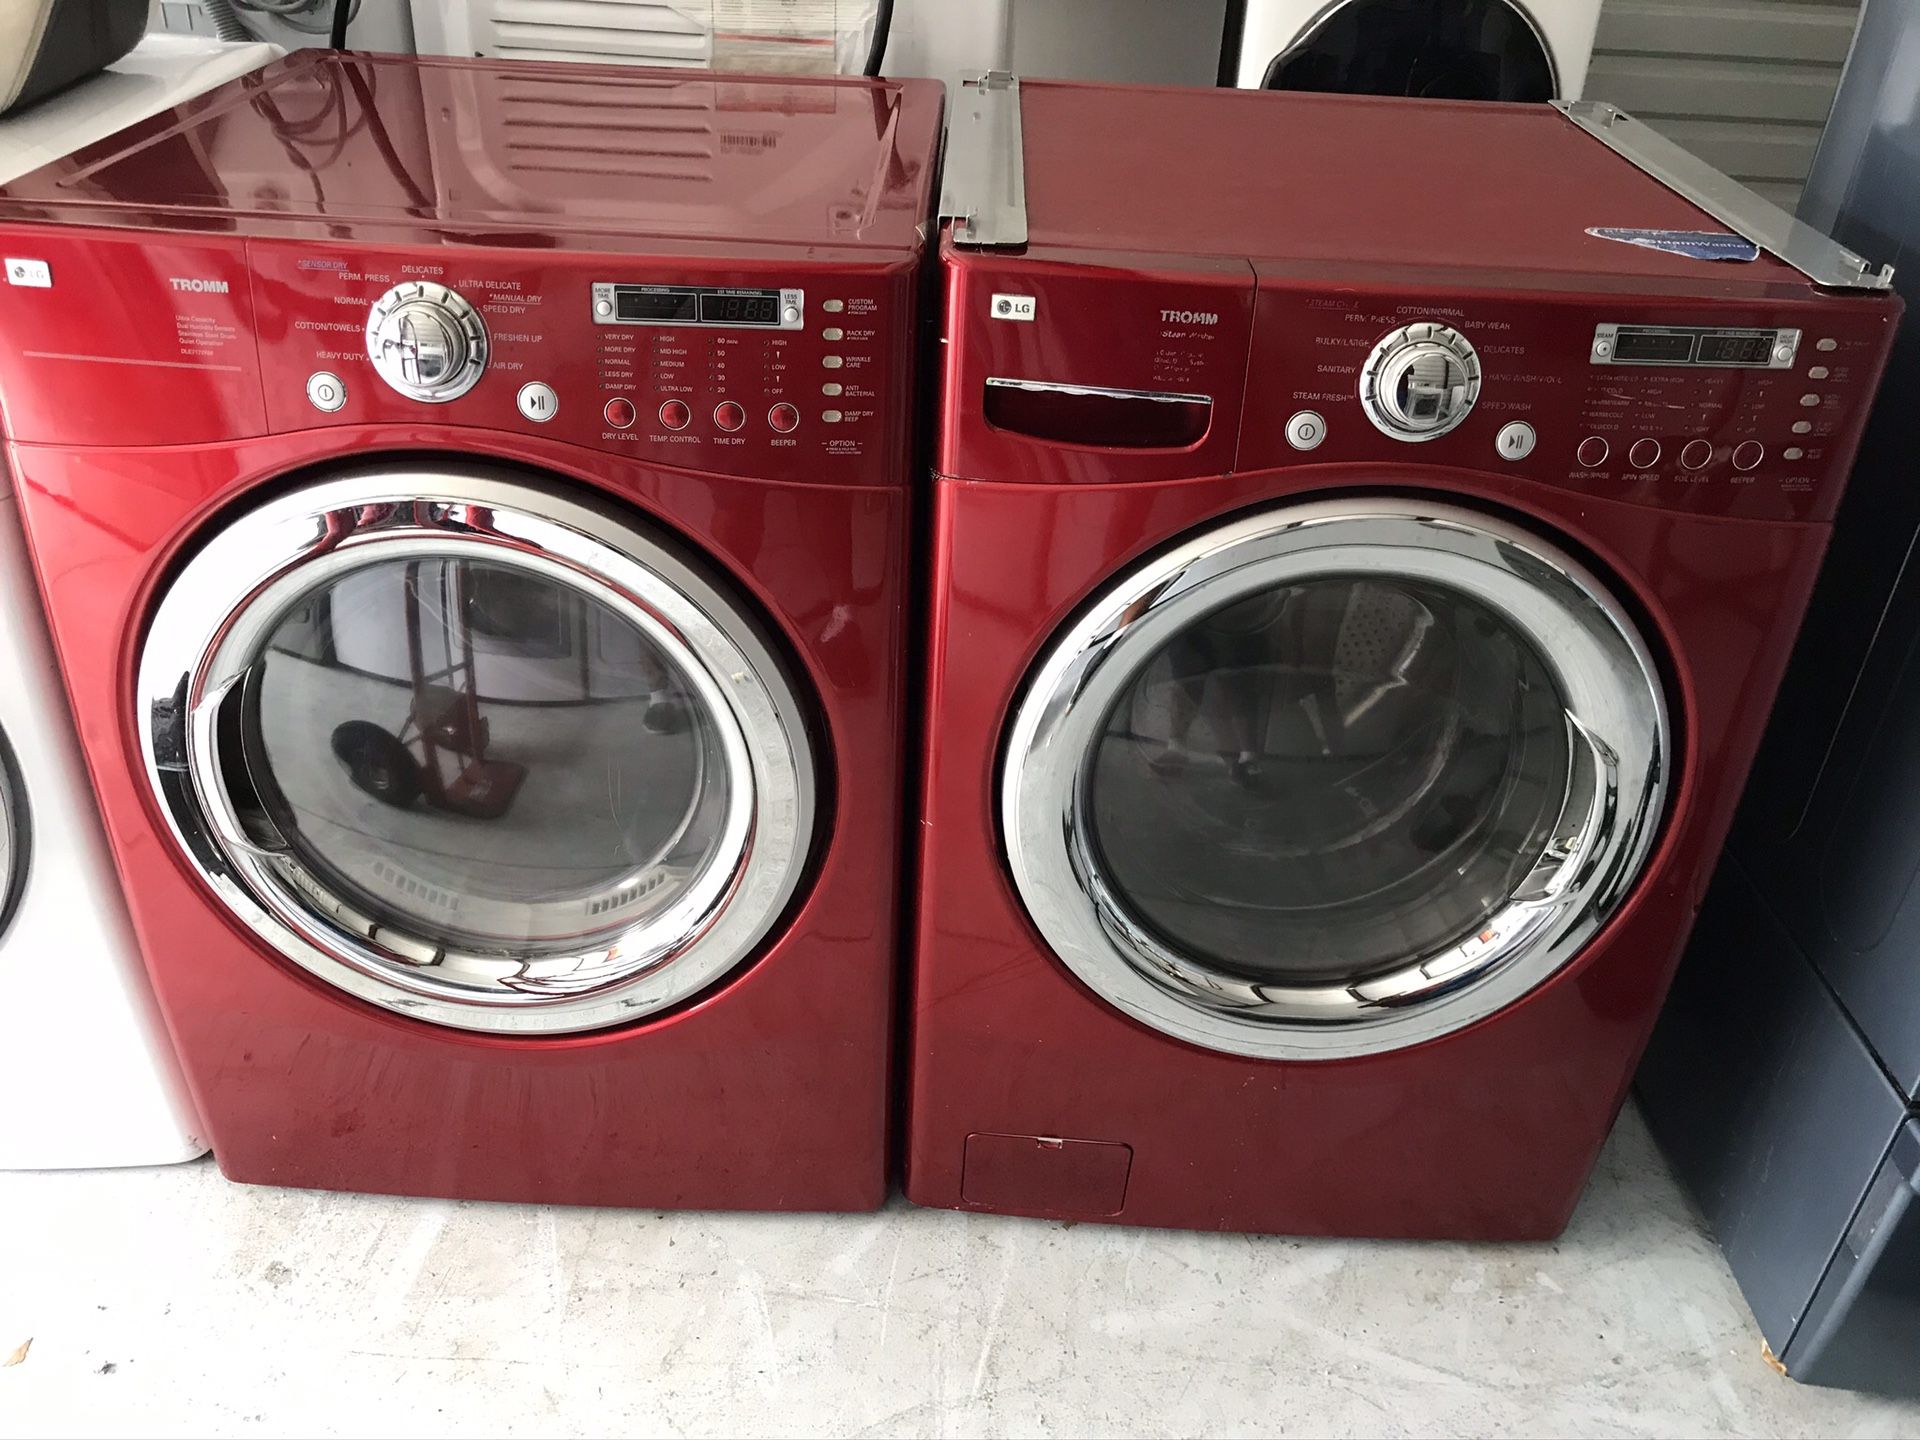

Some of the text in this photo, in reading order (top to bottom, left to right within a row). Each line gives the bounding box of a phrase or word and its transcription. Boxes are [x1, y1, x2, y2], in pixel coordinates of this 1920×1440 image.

[329, 261, 348, 269] DRY
[402, 265, 443, 275] DELICATES
[339, 272, 390, 283] PERM. PRESS
[169, 278, 229, 294] TROMM
[458, 280, 521, 291] ULTRA DELICATE
[334, 296, 368, 306] NORMAL
[526, 295, 543, 303] DRY
[483, 305, 526, 315] SPEED DRY
[1015, 303, 1030, 314] LG
[1396, 306, 1465, 317] COTTON/NORMAL
[1160, 309, 1219, 325] TROMM
[295, 321, 361, 333] COTTON/TOWELS
[1464, 321, 1486, 329] BABY
[493, 333, 543, 343] FRESHEN UP
[660, 335, 675, 343] HIGH
[1483, 345, 1525, 355] DELICATES
[316, 352, 365, 362] HEAVY DUTY
[492, 362, 524, 371] AIR DRY
[1317, 364, 1356, 374] SANITARY
[624, 383, 637, 391] DRY
[1293, 391, 1321, 401] STEAM
[1507, 402, 1532, 411] WASH
[602, 432, 640, 442] DRY LEVEL
[649, 434, 702, 444] TEMP. CONTROL
[713, 437, 746, 446] TIME DRY
[770, 439, 797, 447] BEEPER
[1621, 472, 1660, 482] SPIN SPEED
[1730, 476, 1755, 485] BEEPER
